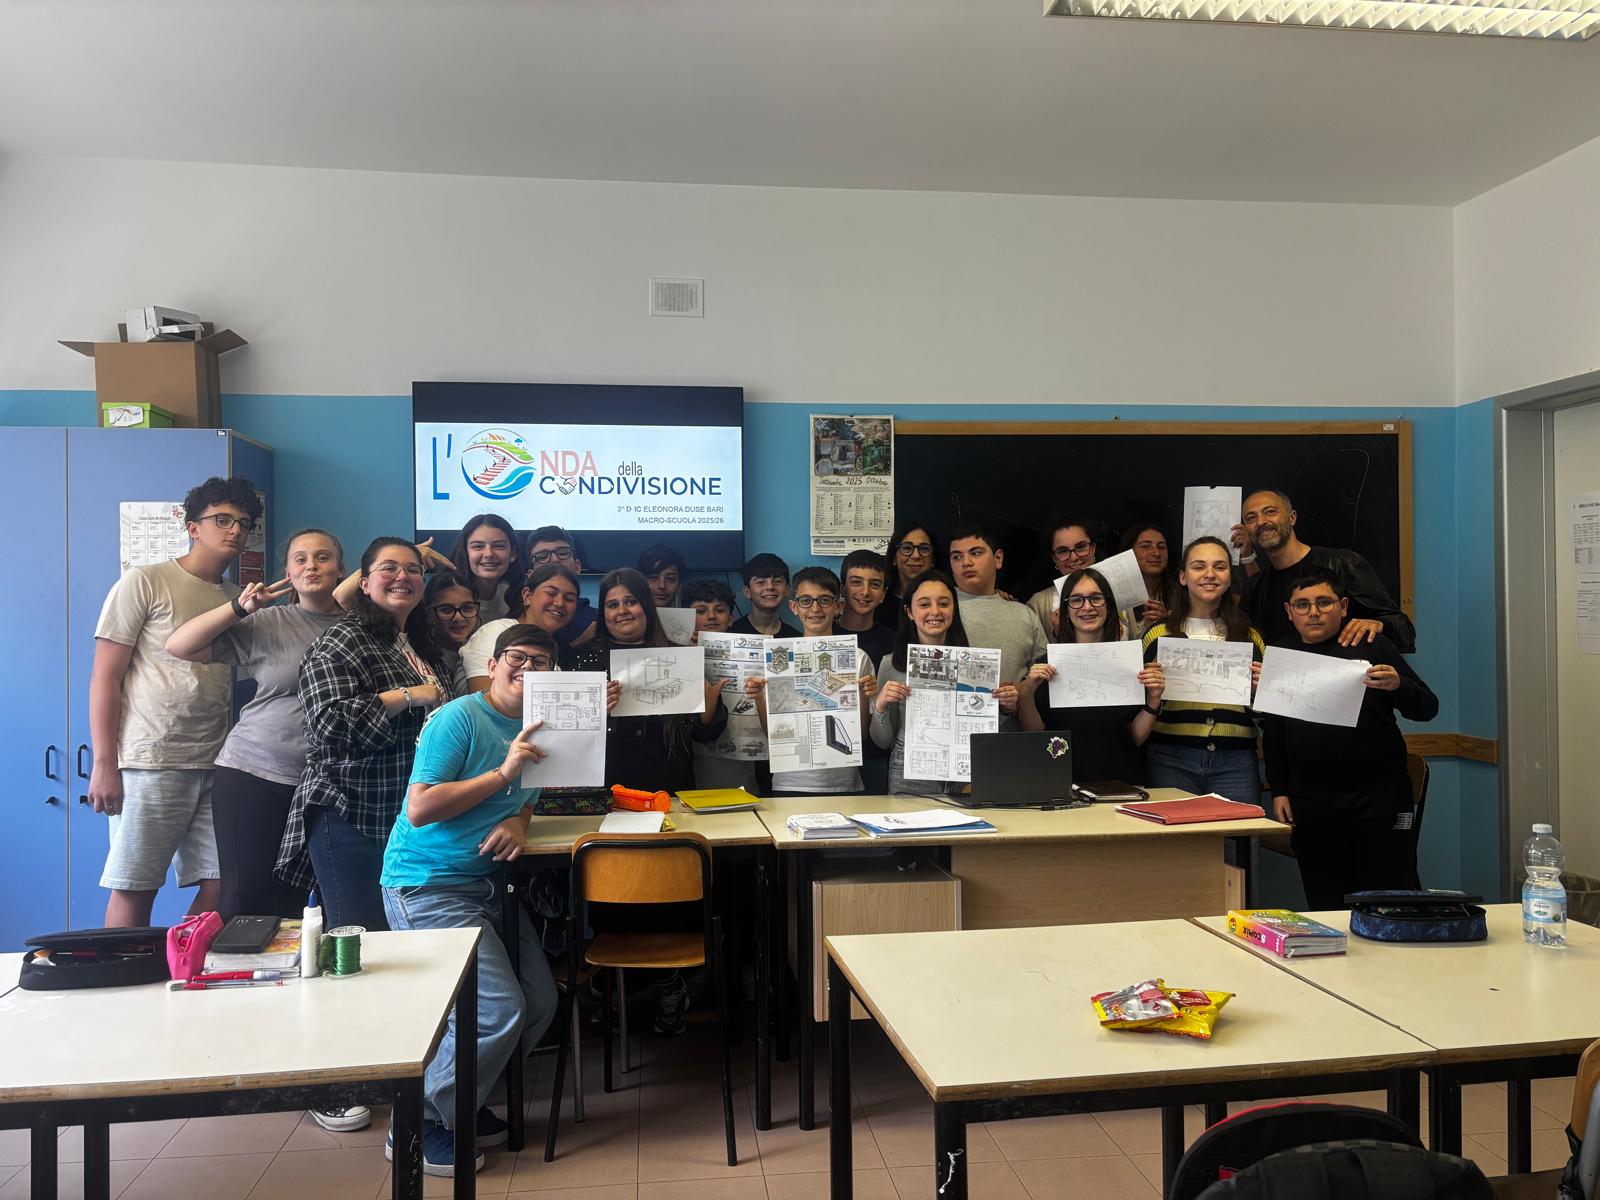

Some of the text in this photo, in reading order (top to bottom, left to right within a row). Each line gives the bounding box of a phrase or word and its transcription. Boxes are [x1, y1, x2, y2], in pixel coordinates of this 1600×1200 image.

[617, 461, 643, 476] della
[846, 476, 863, 486] 2025
[643, 505, 684, 513] ELEONORA
[685, 505, 705, 513] DUSE
[706, 505, 724, 513] BARI
